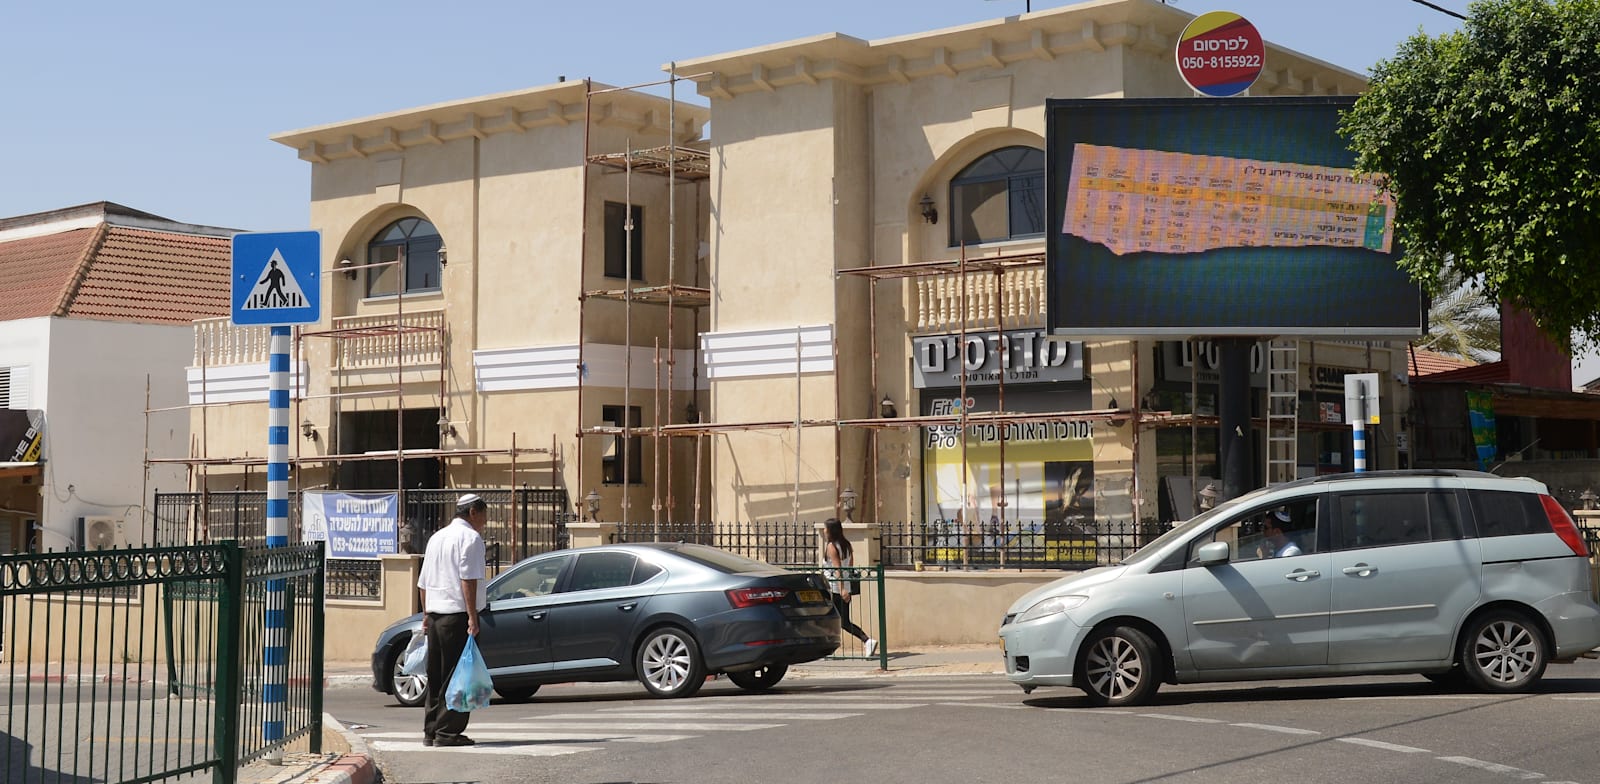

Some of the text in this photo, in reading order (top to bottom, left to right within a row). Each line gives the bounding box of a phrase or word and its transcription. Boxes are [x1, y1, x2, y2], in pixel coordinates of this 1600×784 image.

[1194, 36, 1248, 51] לפרסום
[1182, 55, 1261, 69] 050-8155922
[921, 332, 1068, 373] מדרסים
[932, 400, 952, 416] Fit
[928, 433, 955, 448] Pro
[329, 514, 394, 532] אחרונים להשכרה
